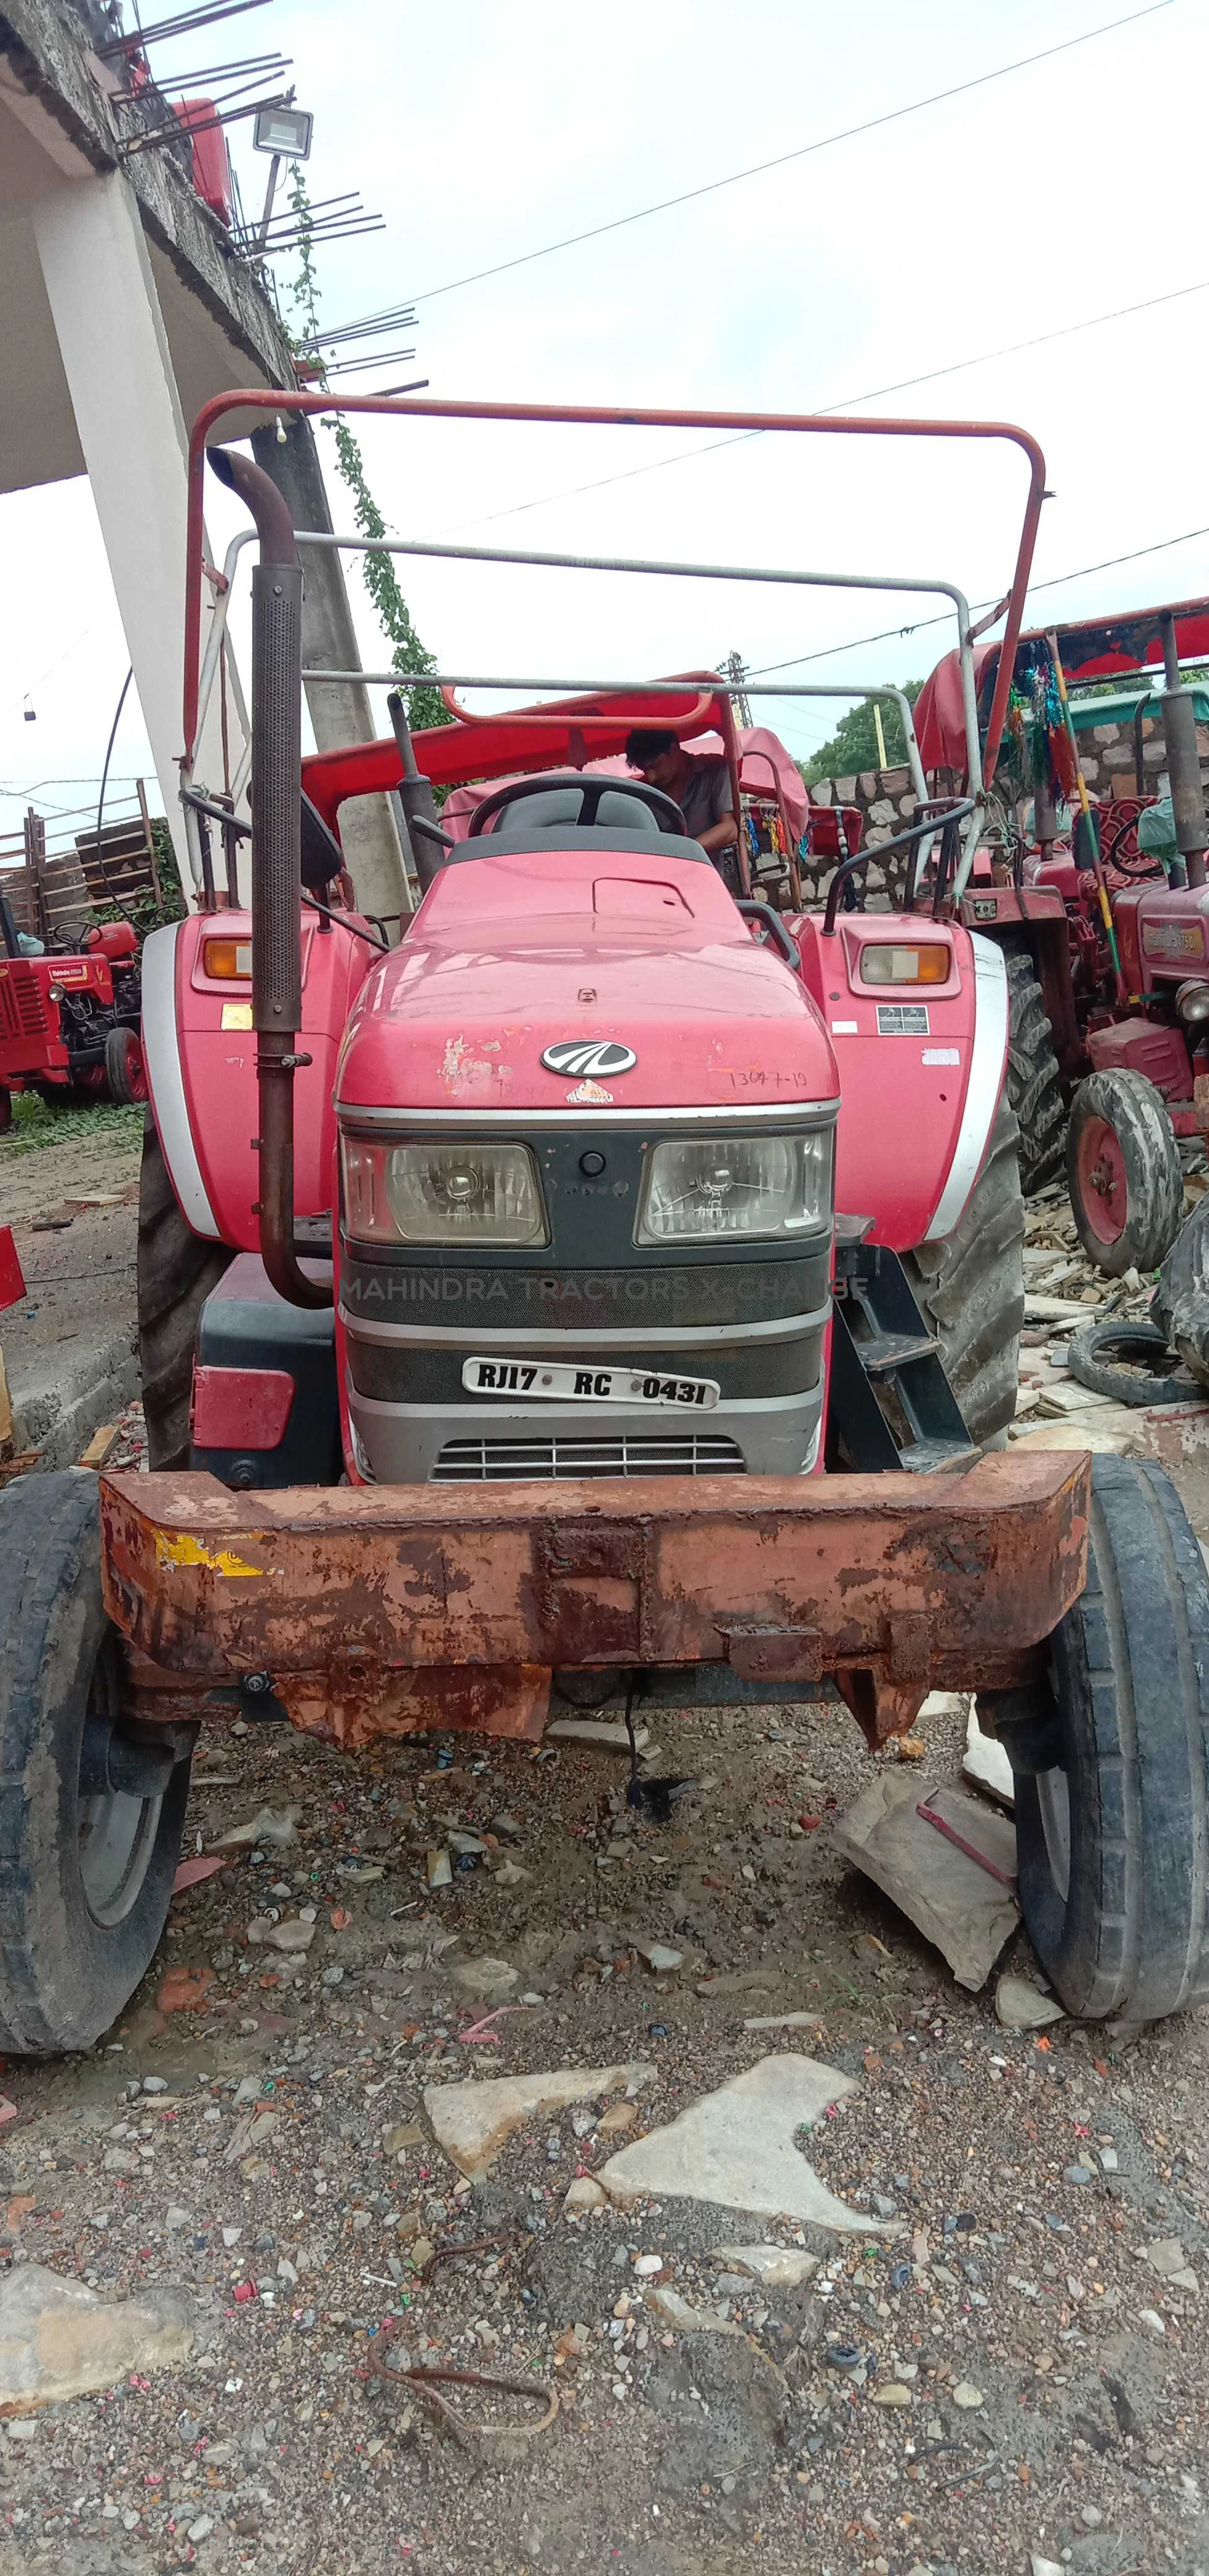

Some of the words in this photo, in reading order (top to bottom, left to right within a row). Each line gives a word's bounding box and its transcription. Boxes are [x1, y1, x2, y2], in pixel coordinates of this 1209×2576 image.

[478, 1364, 537, 1391] RJ17
[574, 1372, 612, 1396] RC
[642, 1378, 706, 1404] 0431
